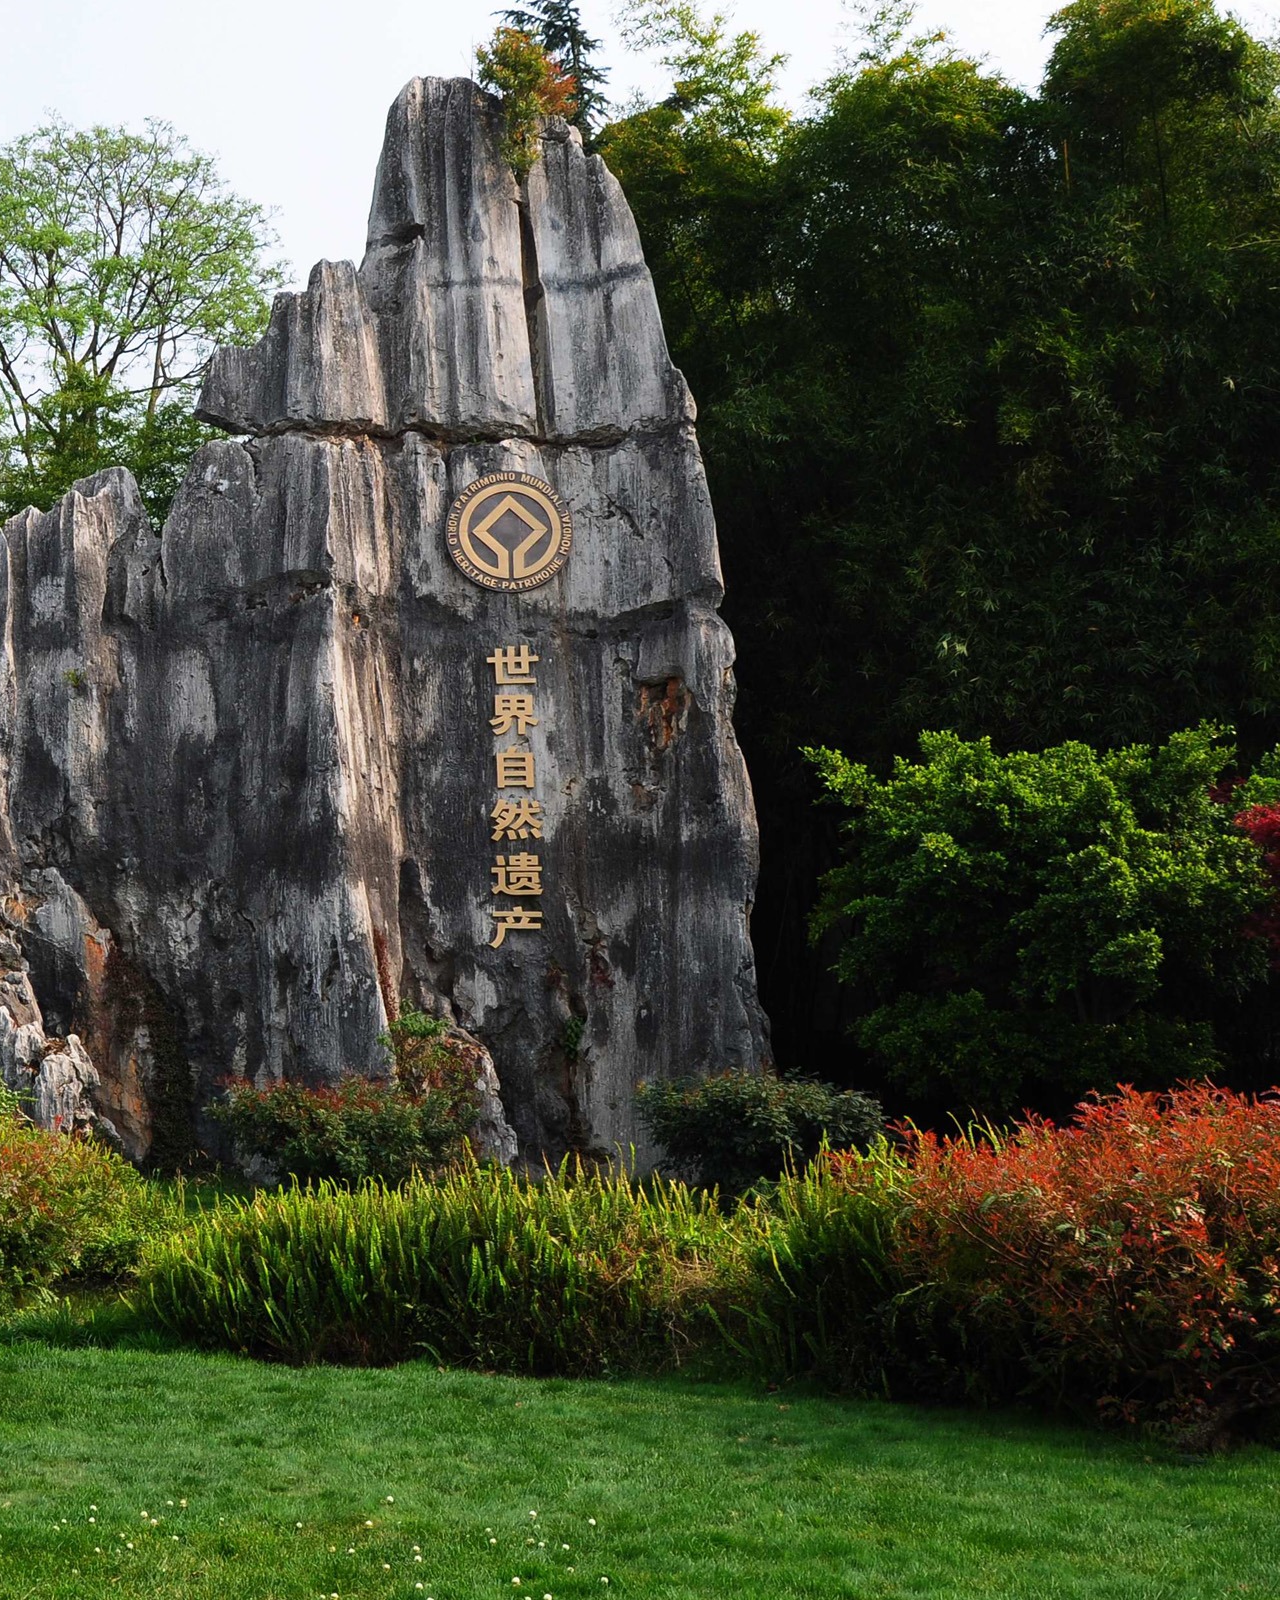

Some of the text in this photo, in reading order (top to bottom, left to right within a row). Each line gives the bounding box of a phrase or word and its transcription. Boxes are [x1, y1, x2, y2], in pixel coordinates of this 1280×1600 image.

[454, 473, 563, 509] PATRIMONIO MUNDIAL
[448, 513, 498, 588] WORLD HERITAGE
[502, 510, 572, 590] PATRIMOINE MONDIAL
[486, 645, 543, 949] 世界自然遗产
